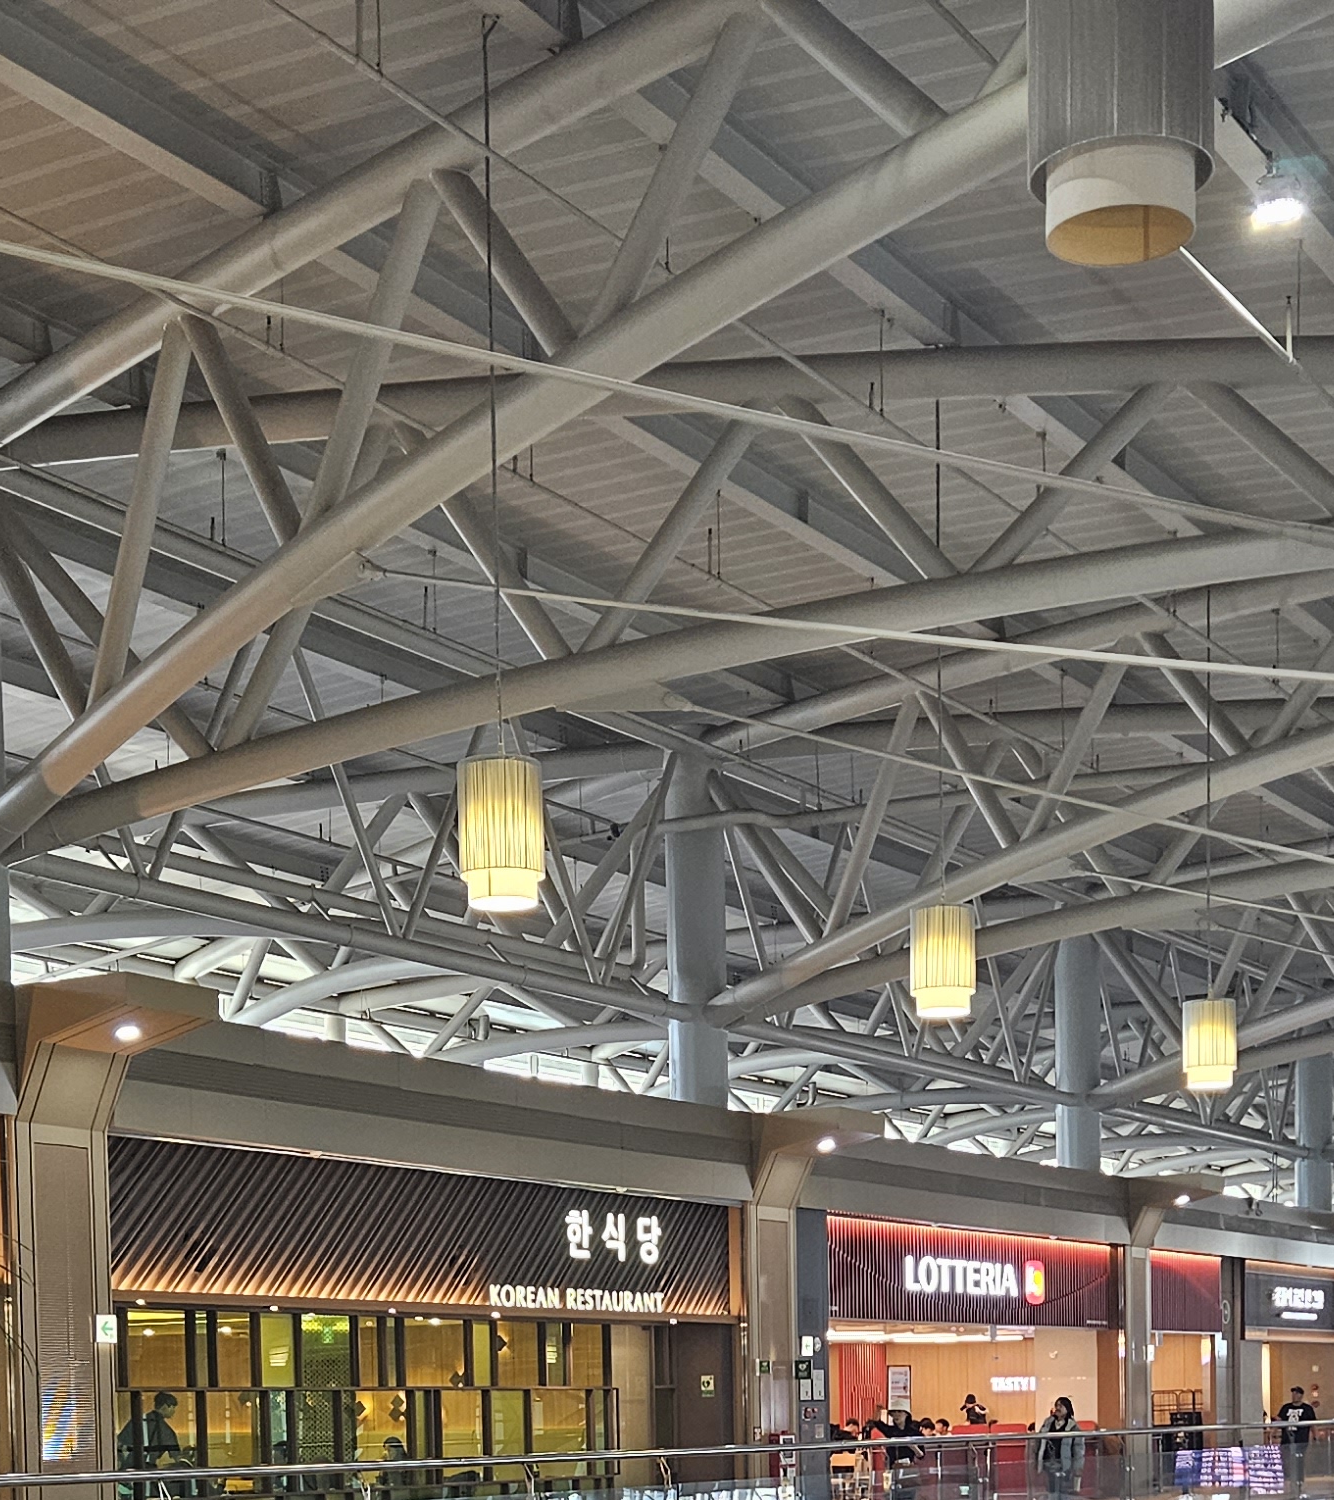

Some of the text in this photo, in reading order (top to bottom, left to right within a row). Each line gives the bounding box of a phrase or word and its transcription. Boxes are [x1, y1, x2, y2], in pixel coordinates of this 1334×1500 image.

[566, 1208, 663, 1265] 한식당
[904, 1254, 1018, 1297] LOTTERIA
[489, 1283, 665, 1313] KOREAN RESTAURANT
